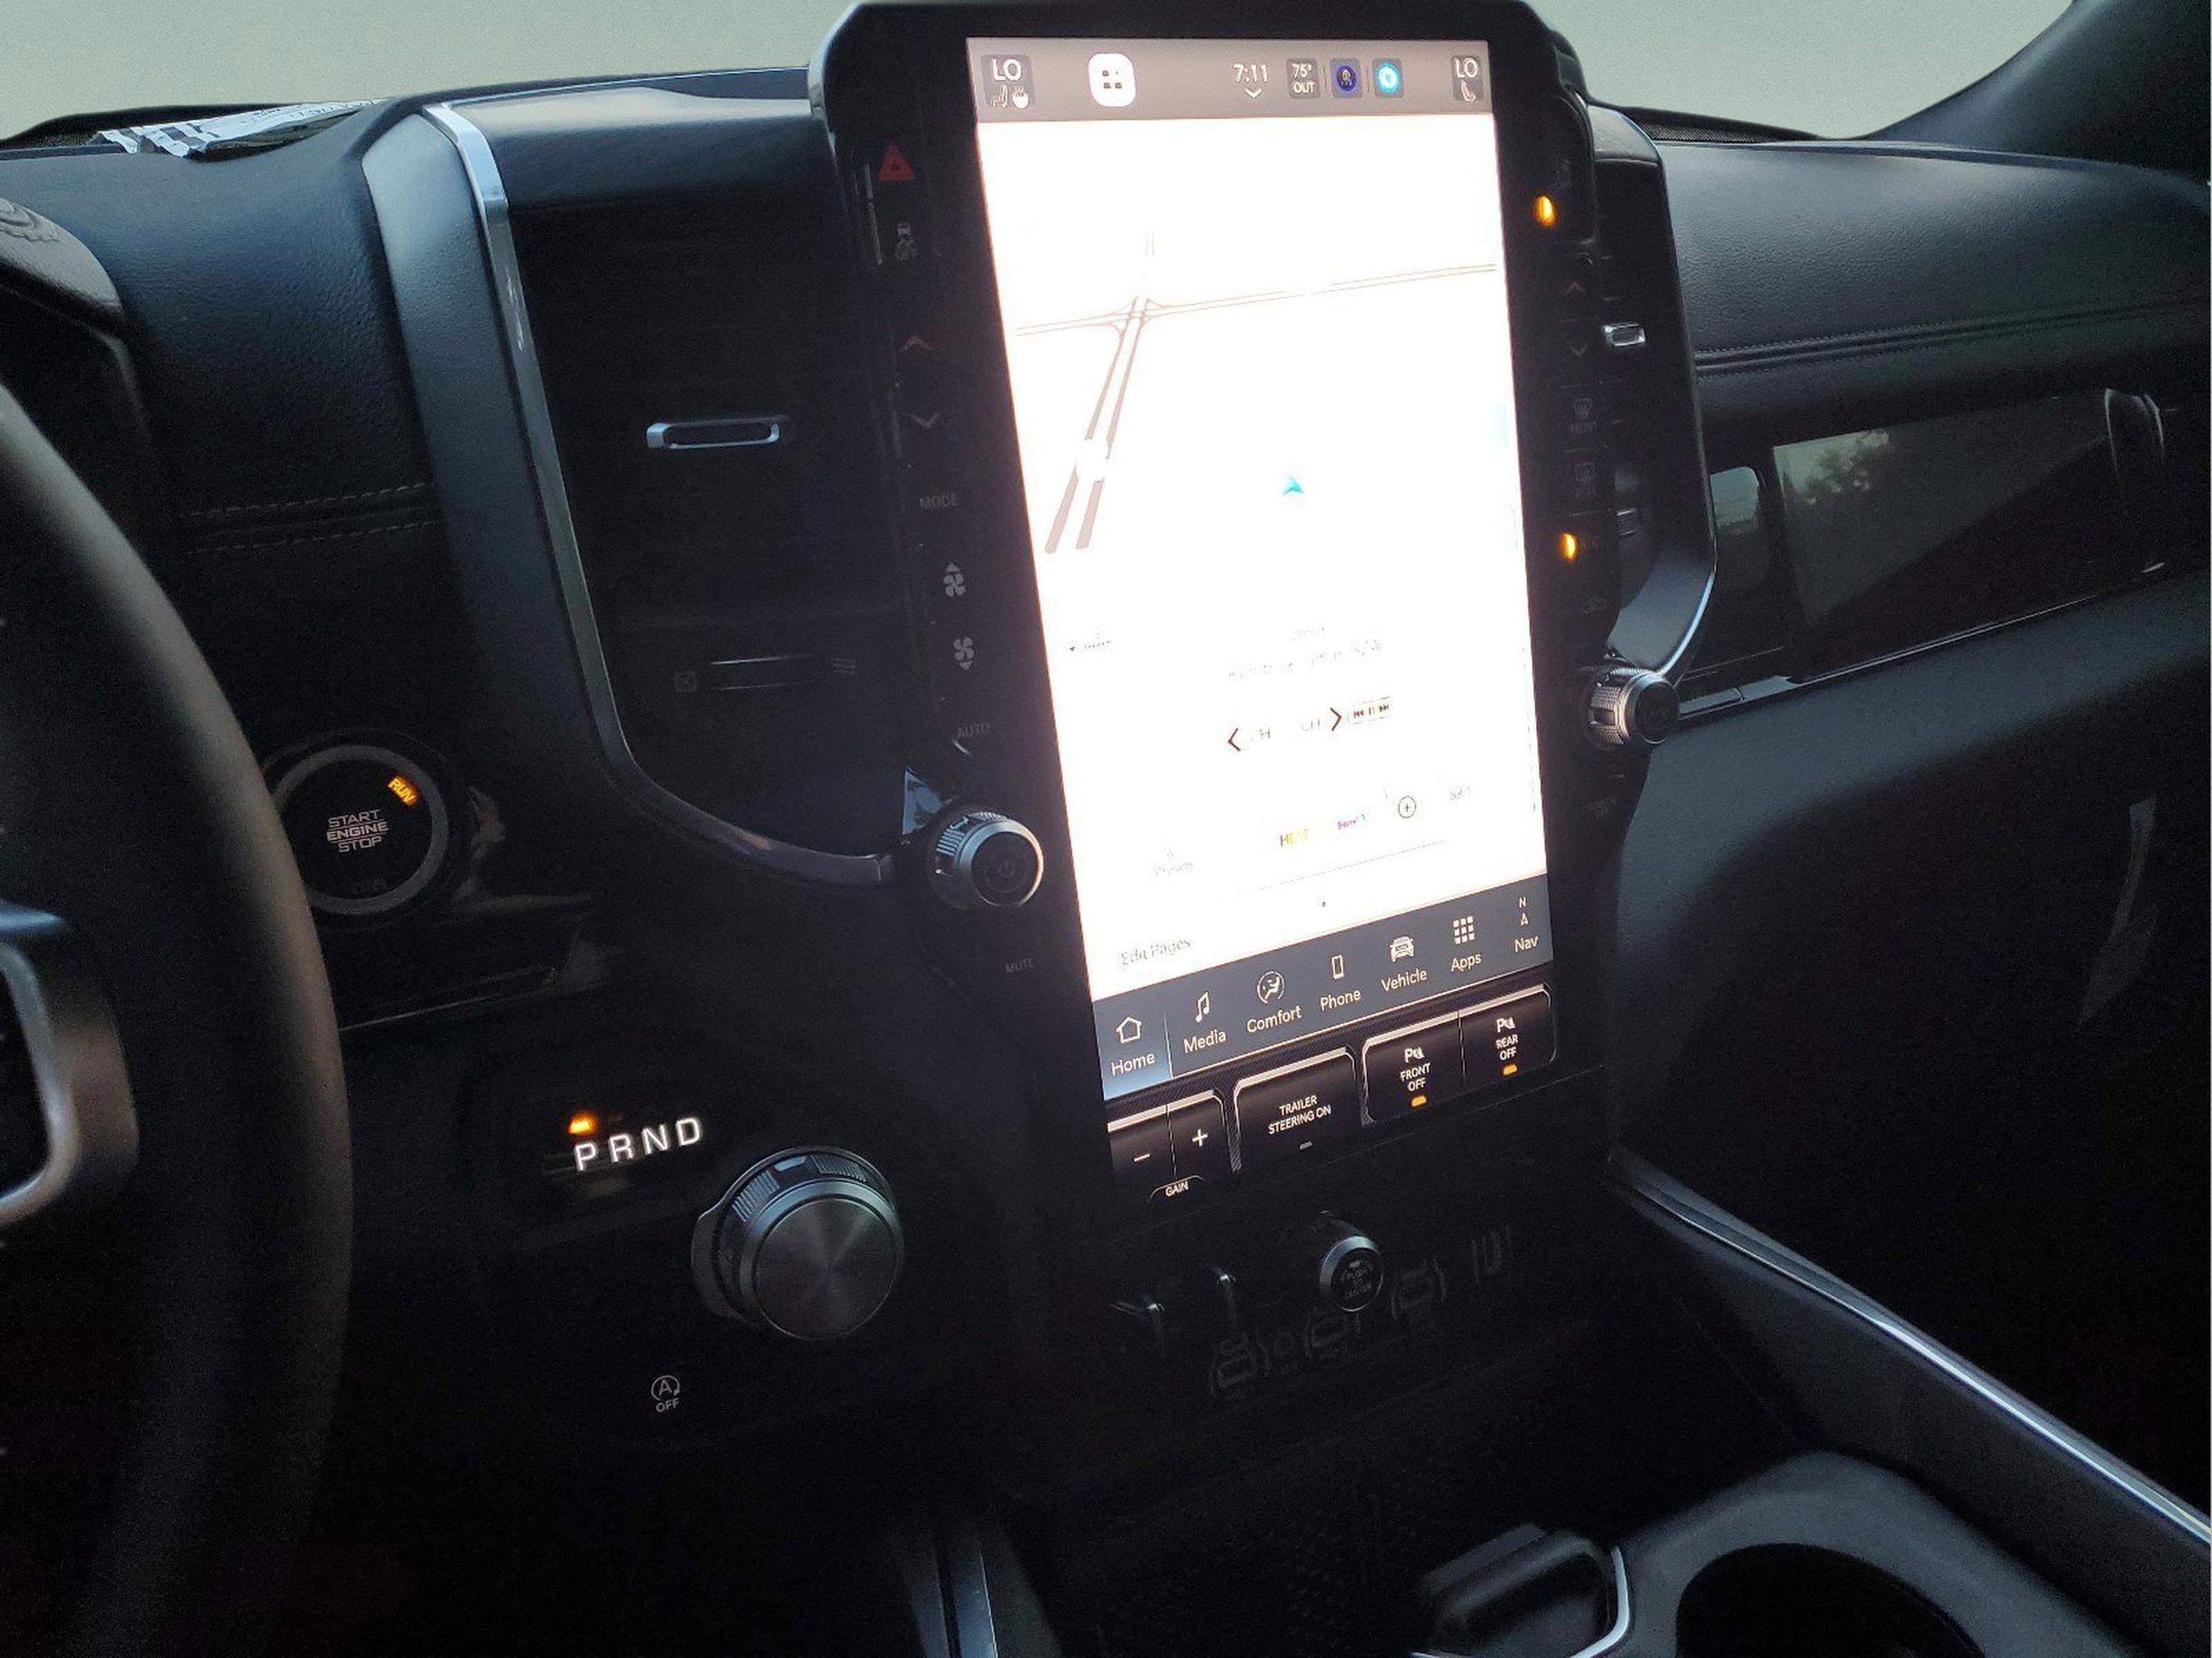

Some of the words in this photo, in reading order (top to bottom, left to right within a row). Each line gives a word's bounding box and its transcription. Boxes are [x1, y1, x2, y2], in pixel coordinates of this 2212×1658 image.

[991, 58, 1023, 82] LO
[1232, 63, 1269, 84] 7:11
[1454, 56, 1479, 78] LO
[1293, 80, 1316, 94] OUT
[387, 775, 418, 805] RUN
[327, 808, 382, 829] START
[326, 820, 389, 843] ENGINE
[338, 834, 383, 854] STOP
[1120, 945, 1149, 966] Edit
[1150, 938, 1192, 960] Pages
[1514, 936, 1539, 953] Nav
[1451, 953, 1482, 973] Apps
[1381, 968, 1428, 992] Vehicle
[1320, 989, 1362, 1012] Phone
[1246, 1005, 1302, 1033] Comfort
[1183, 1029, 1227, 1054] Media
[1496, 1034, 1519, 1050] REAR
[1499, 1046, 1518, 1061] OFF
[1111, 1052, 1156, 1077] Home
[1400, 1062, 1431, 1082] FRONT
[1407, 1077, 1427, 1092] OFF
[1278, 1095, 1318, 1117] TRAILER
[1268, 1109, 1316, 1136] STEERING
[1316, 1105, 1332, 1118] ON
[1165, 1181, 1189, 1197] GAIN
[655, 1398, 680, 1414] OFF
